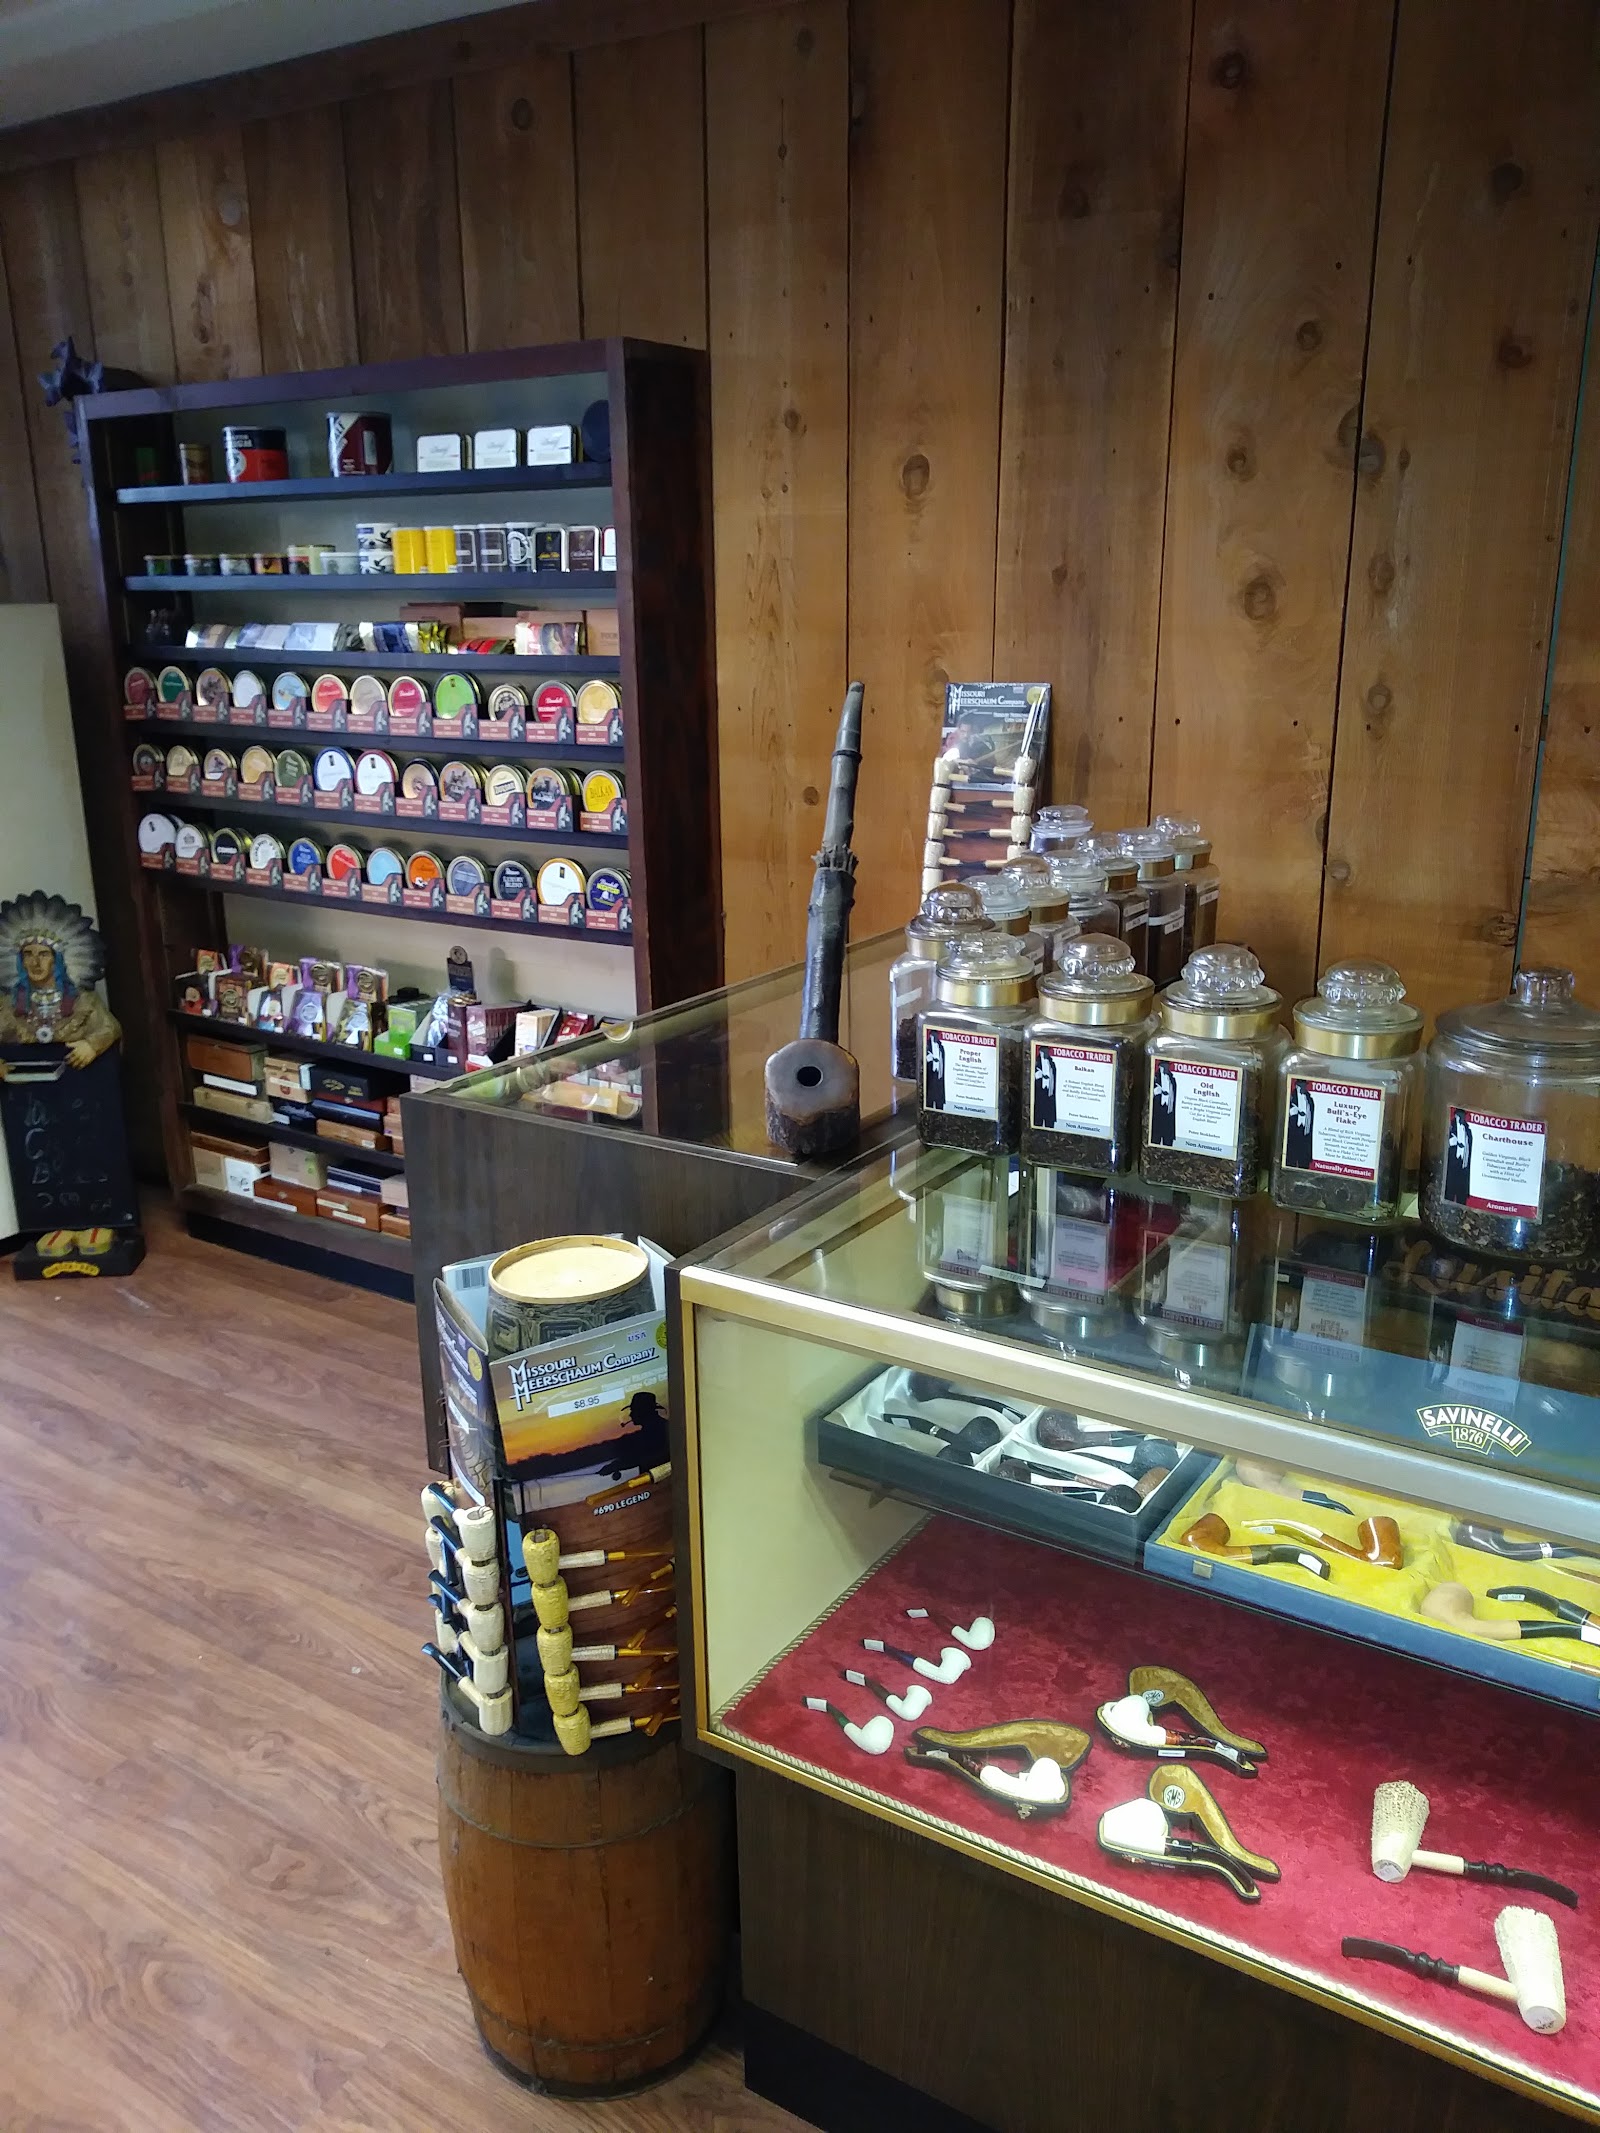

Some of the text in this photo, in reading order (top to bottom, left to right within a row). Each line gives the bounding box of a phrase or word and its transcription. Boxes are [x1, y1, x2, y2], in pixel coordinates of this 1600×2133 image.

[942, 1032, 995, 1046] TOBACCO TRADER
[960, 1048, 981, 1057] Proper
[1053, 1047, 1111, 1062] TOBACCO TRADER
[959, 1055, 982, 1064] English
[1074, 1065, 1094, 1073] Balkan
[1173, 1063, 1236, 1079] TOBACCO TRADER
[1200, 1081, 1214, 1089] Old
[1312, 1082, 1379, 1099] TOBACCO TRADER
[1192, 1088, 1220, 1098] English
[965, 1106, 986, 1114] Aromatic
[1333, 1101, 1361, 1111] Luxury
[1326, 1107, 1367, 1120] Bull's-Eye
[1335, 1116, 1357, 1125] Flake
[1470, 1113, 1543, 1132] TOBACCO TRADER
[1077, 1124, 1100, 1132] Aromatic
[1482, 1132, 1534, 1147] Charthouse
[1197, 1143, 1222, 1151] Aromatic
[1314, 1162, 1371, 1176] Naturally Aromatic
[1486, 1202, 1518, 1212] Aromatic
[627, 1331, 647, 1343] USA
[508, 1356, 577, 1384] MISSOURI
[510, 1347, 656, 1410] MEERSCHAUM Company
[574, 1395, 600, 1409] $8.95
[1423, 1406, 1523, 1447] SAVINELLI
[1455, 1427, 1484, 1445] 1876
[593, 1491, 651, 1516] #690 LEGEND
